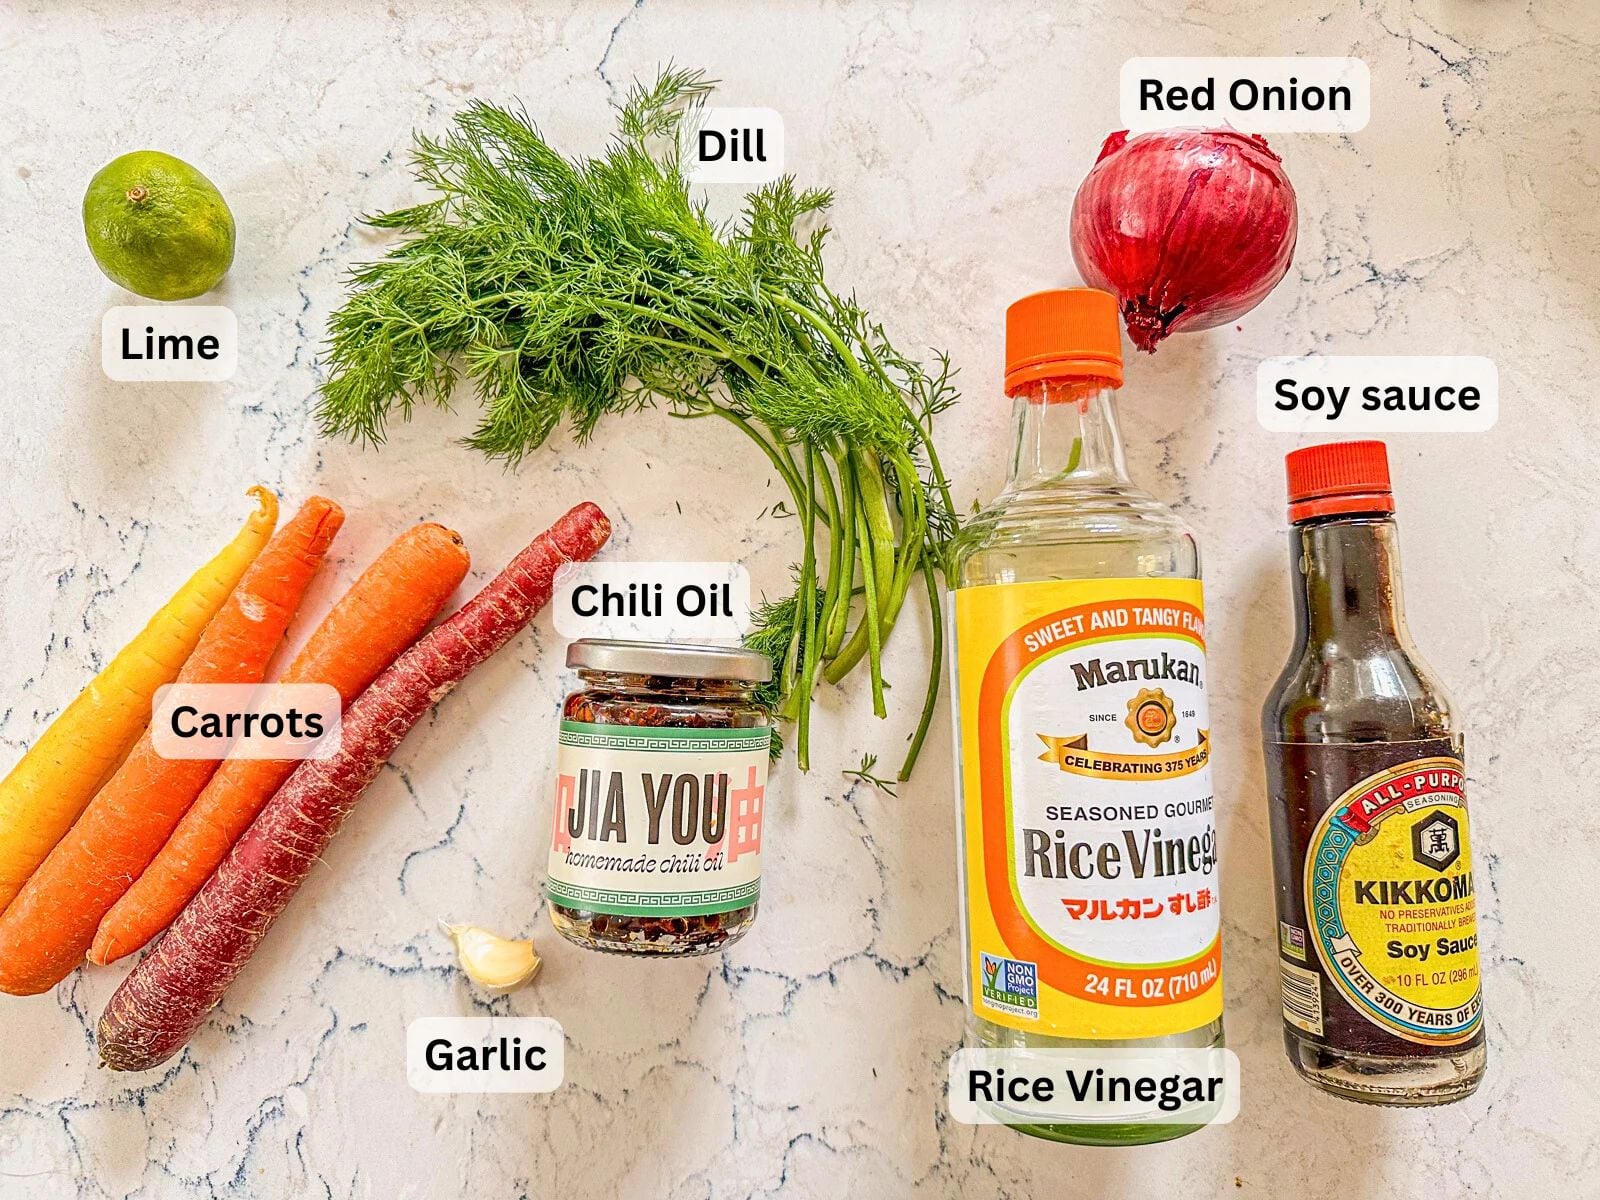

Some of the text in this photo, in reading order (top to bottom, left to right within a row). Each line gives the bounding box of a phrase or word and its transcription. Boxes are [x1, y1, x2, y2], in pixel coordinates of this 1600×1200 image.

[1024, 615, 1084, 652] SWEET
[1090, 608, 1129, 630] AND
[1132, 607, 1180, 627] TANGY
[1070, 652, 1199, 691] Marukan
[1089, 710, 1195, 722] SINCE 1649
[1064, 755, 1163, 774] CELEBRATING
[1165, 760, 1183, 772] 375
[568, 768, 627, 844] JIA
[641, 773, 728, 845] YOU
[1406, 794, 1458, 808] SEASONING
[1046, 804, 1158, 821] SEASONED
[565, 846, 724, 874] homemade chili oil
[1022, 828, 1121, 880] Rice
[1061, 897, 1163, 921] マルカン
[1380, 910, 1395, 920] NO
[1398, 903, 1465, 919] PRESERVATIVES
[1385, 919, 1456, 933] TRADITIONALLY
[1387, 933, 1478, 961] Soy Sauce
[1007, 962, 1033, 976] NON
[1084, 957, 1216, 1000] 24 FL OZ (710 mL)
[1397, 974, 1412, 987] 10
[1415, 973, 1428, 987] FL
[1432, 971, 1446, 985] OZ
[1449, 967, 1468, 985] (296
[1007, 973, 1034, 987] GMO
[1007, 983, 1034, 995] Project
[984, 987, 1035, 1008] VERIFIED
[1340, 957, 1374, 995] OVER
[1375, 992, 1404, 1014] 300
[1407, 1007, 1453, 1026] YEARS
[1457, 1006, 1470, 1021] OF
